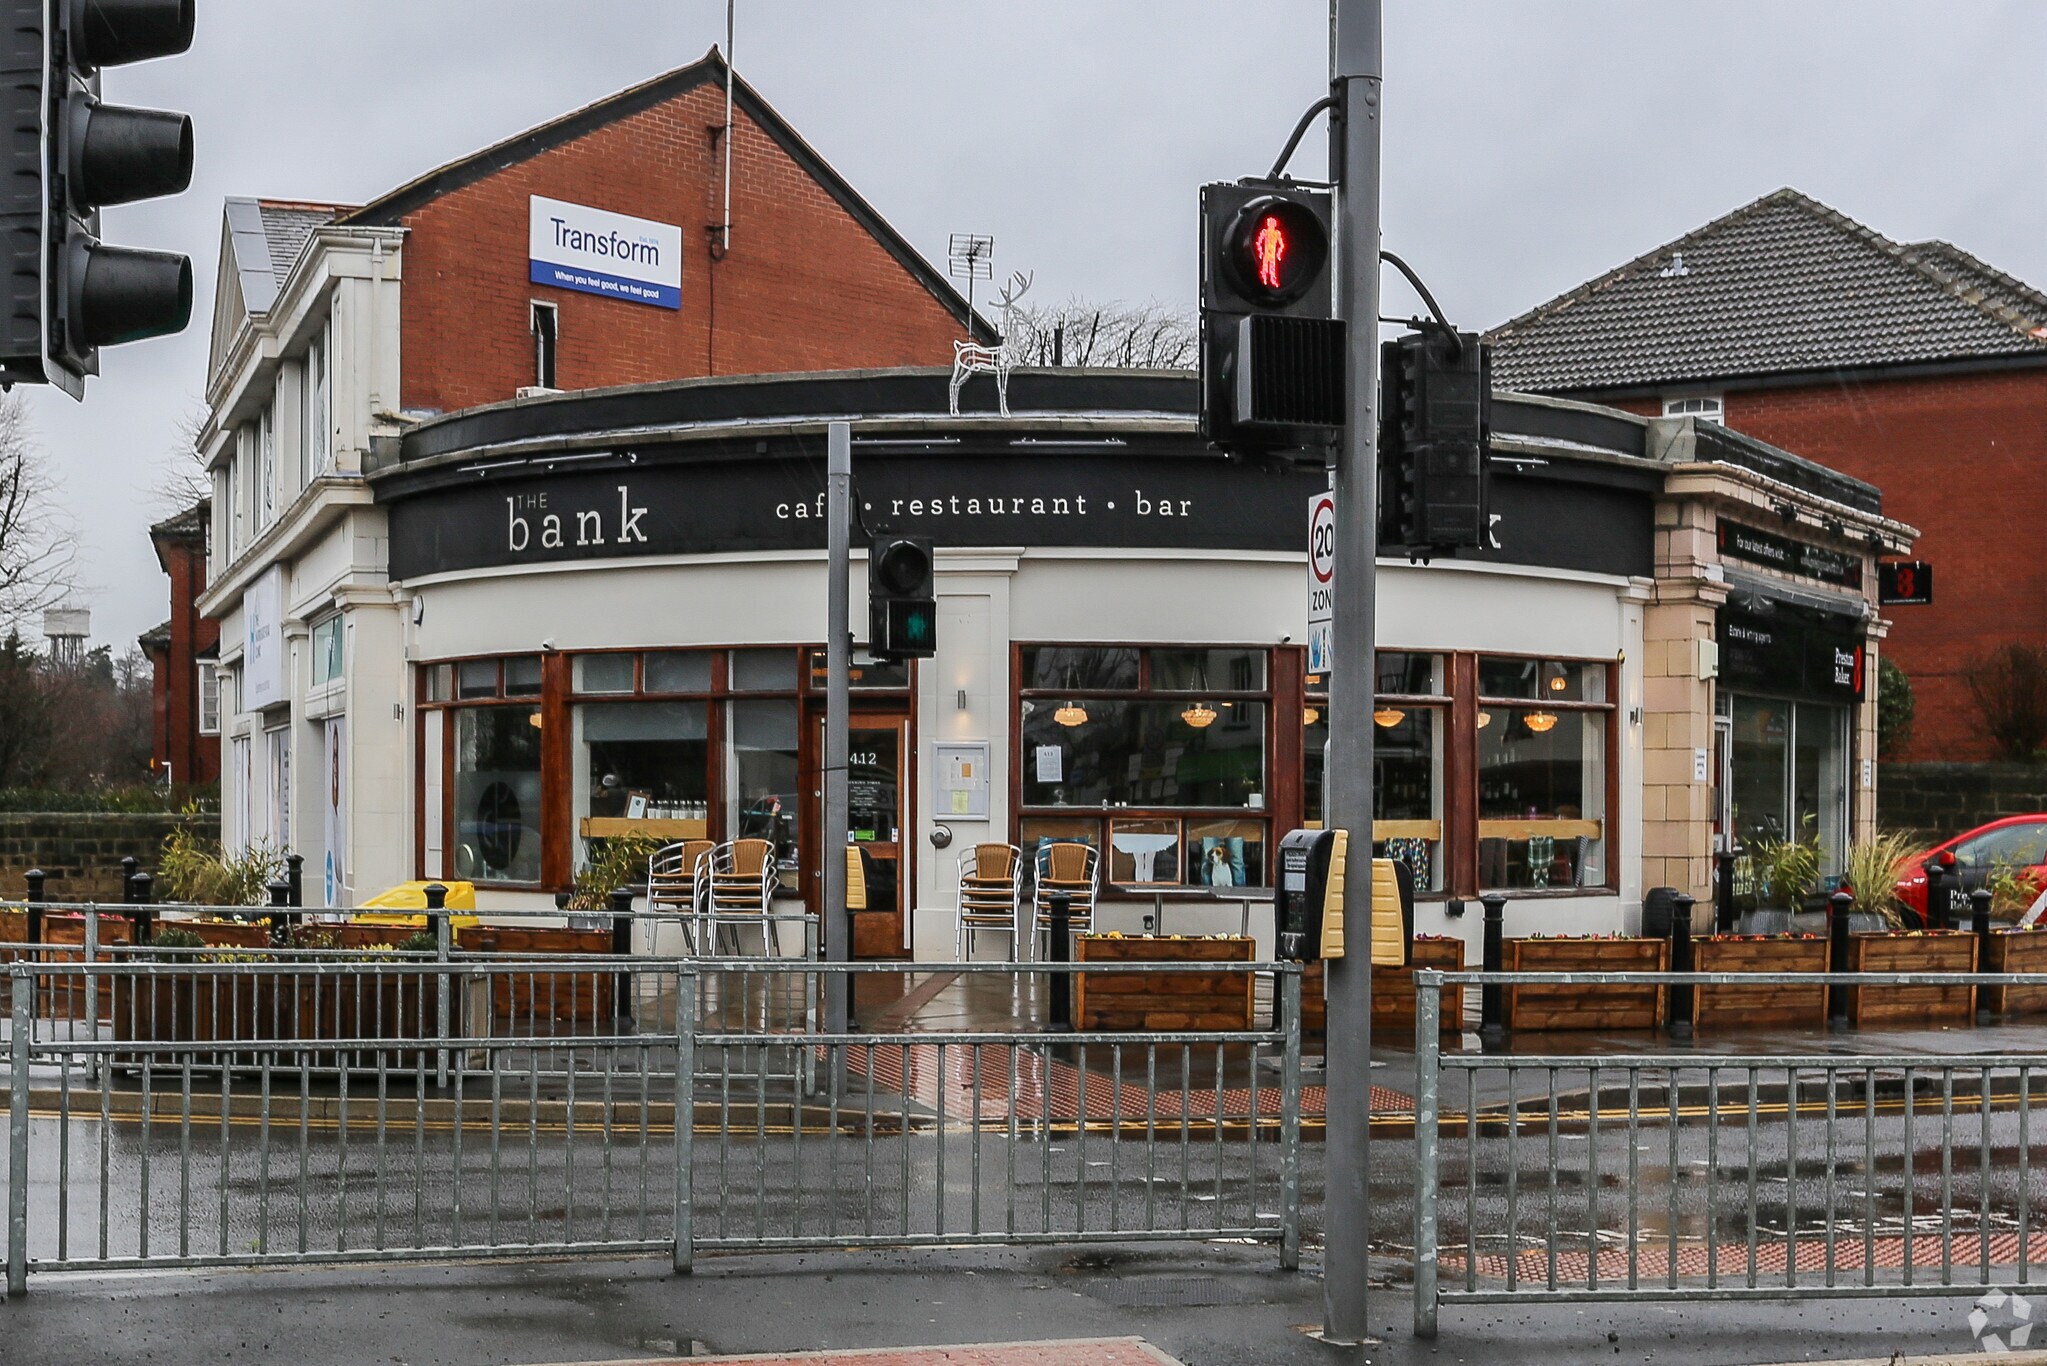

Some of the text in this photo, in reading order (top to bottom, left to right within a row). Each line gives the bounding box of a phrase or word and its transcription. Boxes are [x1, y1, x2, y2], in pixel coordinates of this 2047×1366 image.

[550, 217, 659, 266] Transform
[554, 270, 574, 282] When
[575, 275, 587, 285] you
[588, 276, 600, 287] feel
[630, 284, 642, 295] feel
[642, 288, 660, 299] good
[517, 492, 548, 510] THE
[776, 489, 1192, 519] caf restaurant bar
[506, 485, 648, 551] bank
[1315, 523, 1334, 559] 20
[1312, 588, 1332, 611] ZON
[1835, 646, 1854, 667] Preston
[1835, 666, 1851, 685] Baker
[850, 752, 877, 765] 412
